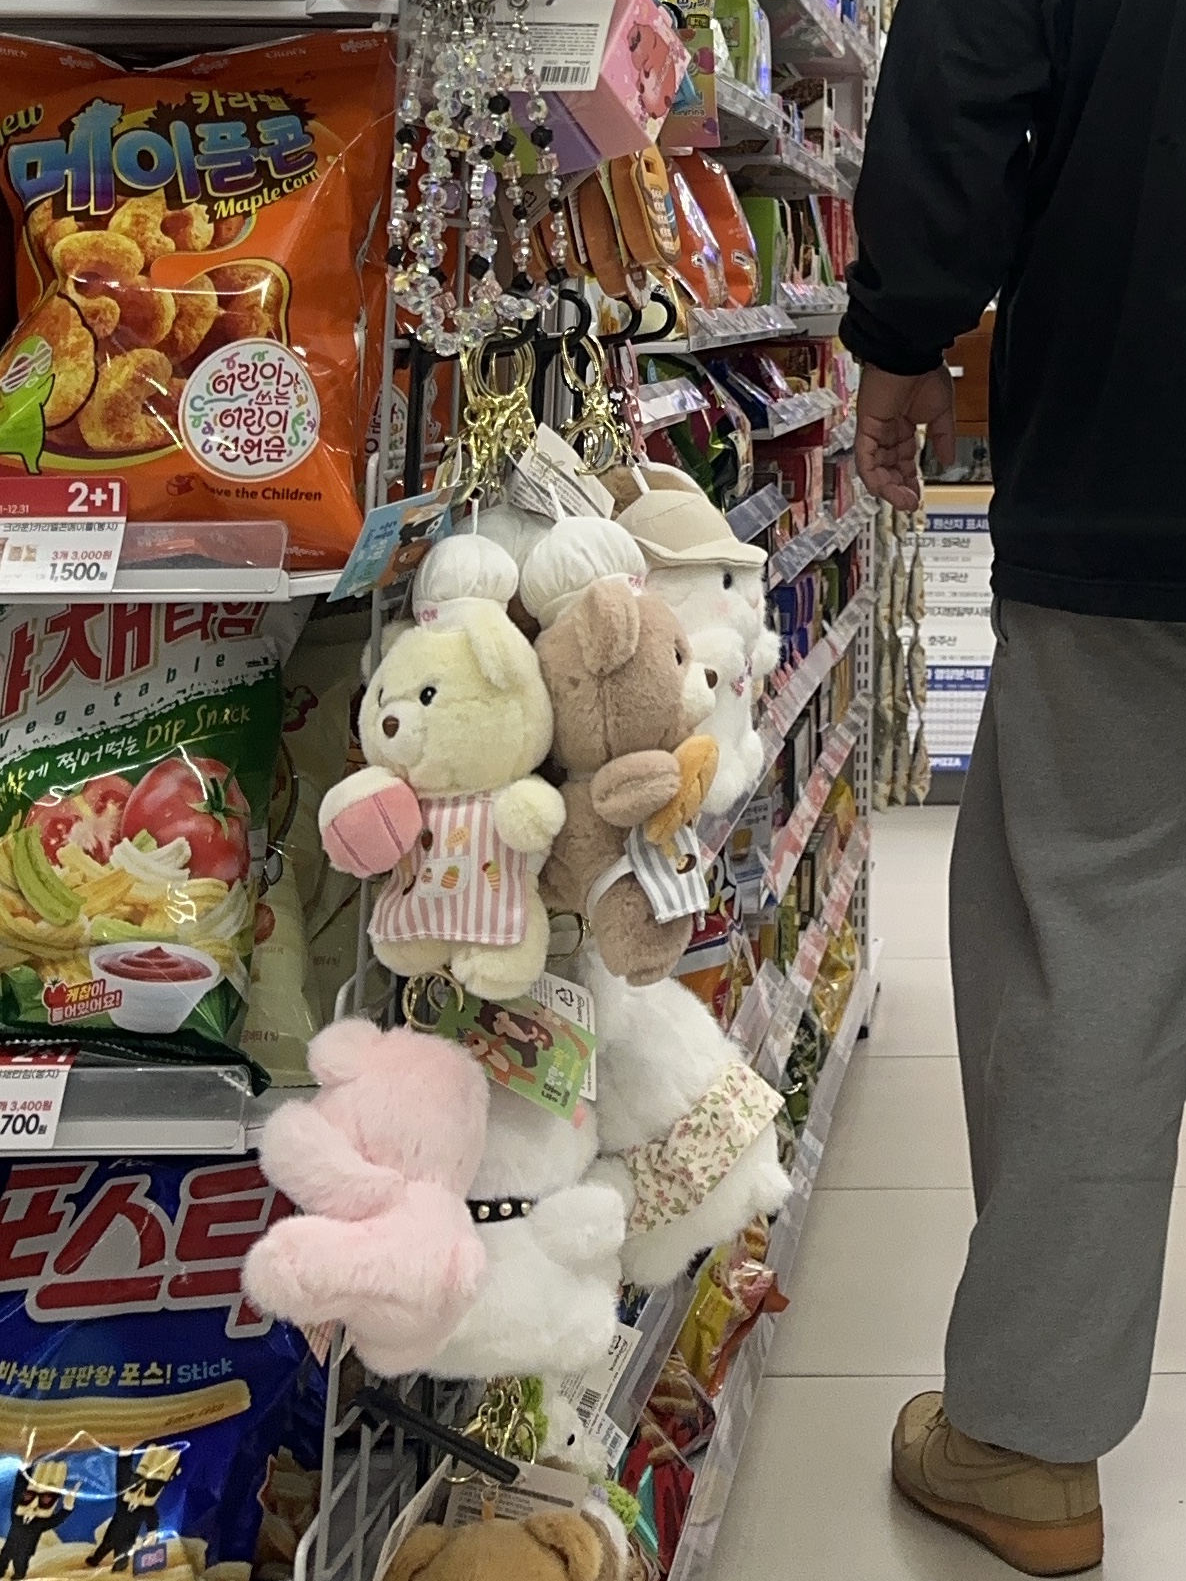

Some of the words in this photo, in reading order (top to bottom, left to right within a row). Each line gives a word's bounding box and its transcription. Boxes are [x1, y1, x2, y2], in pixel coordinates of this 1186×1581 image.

[0, 103, 44, 145] ew
[8, 98, 319, 217] 메이플콘
[214, 188, 282, 222] Maple
[282, 167, 322, 196] Corn
[219, 406, 290, 437] 어린이
[67, 481, 121, 513] 2+1
[235, 486, 258, 500] the
[261, 487, 323, 502] Children
[56, 736, 141, 776] 찍어먹는
[145, 719, 187, 749] Dip
[190, 703, 252, 737] Snack
[51, 991, 122, 1022] 들어있어요!
[66, 980, 105, 1004] 케찹이
[0, 1069, 59, 1080] 채타임(봉지)
[0, 1114, 48, 1136] 700원
[177, 1358, 233, 1384] Stick
